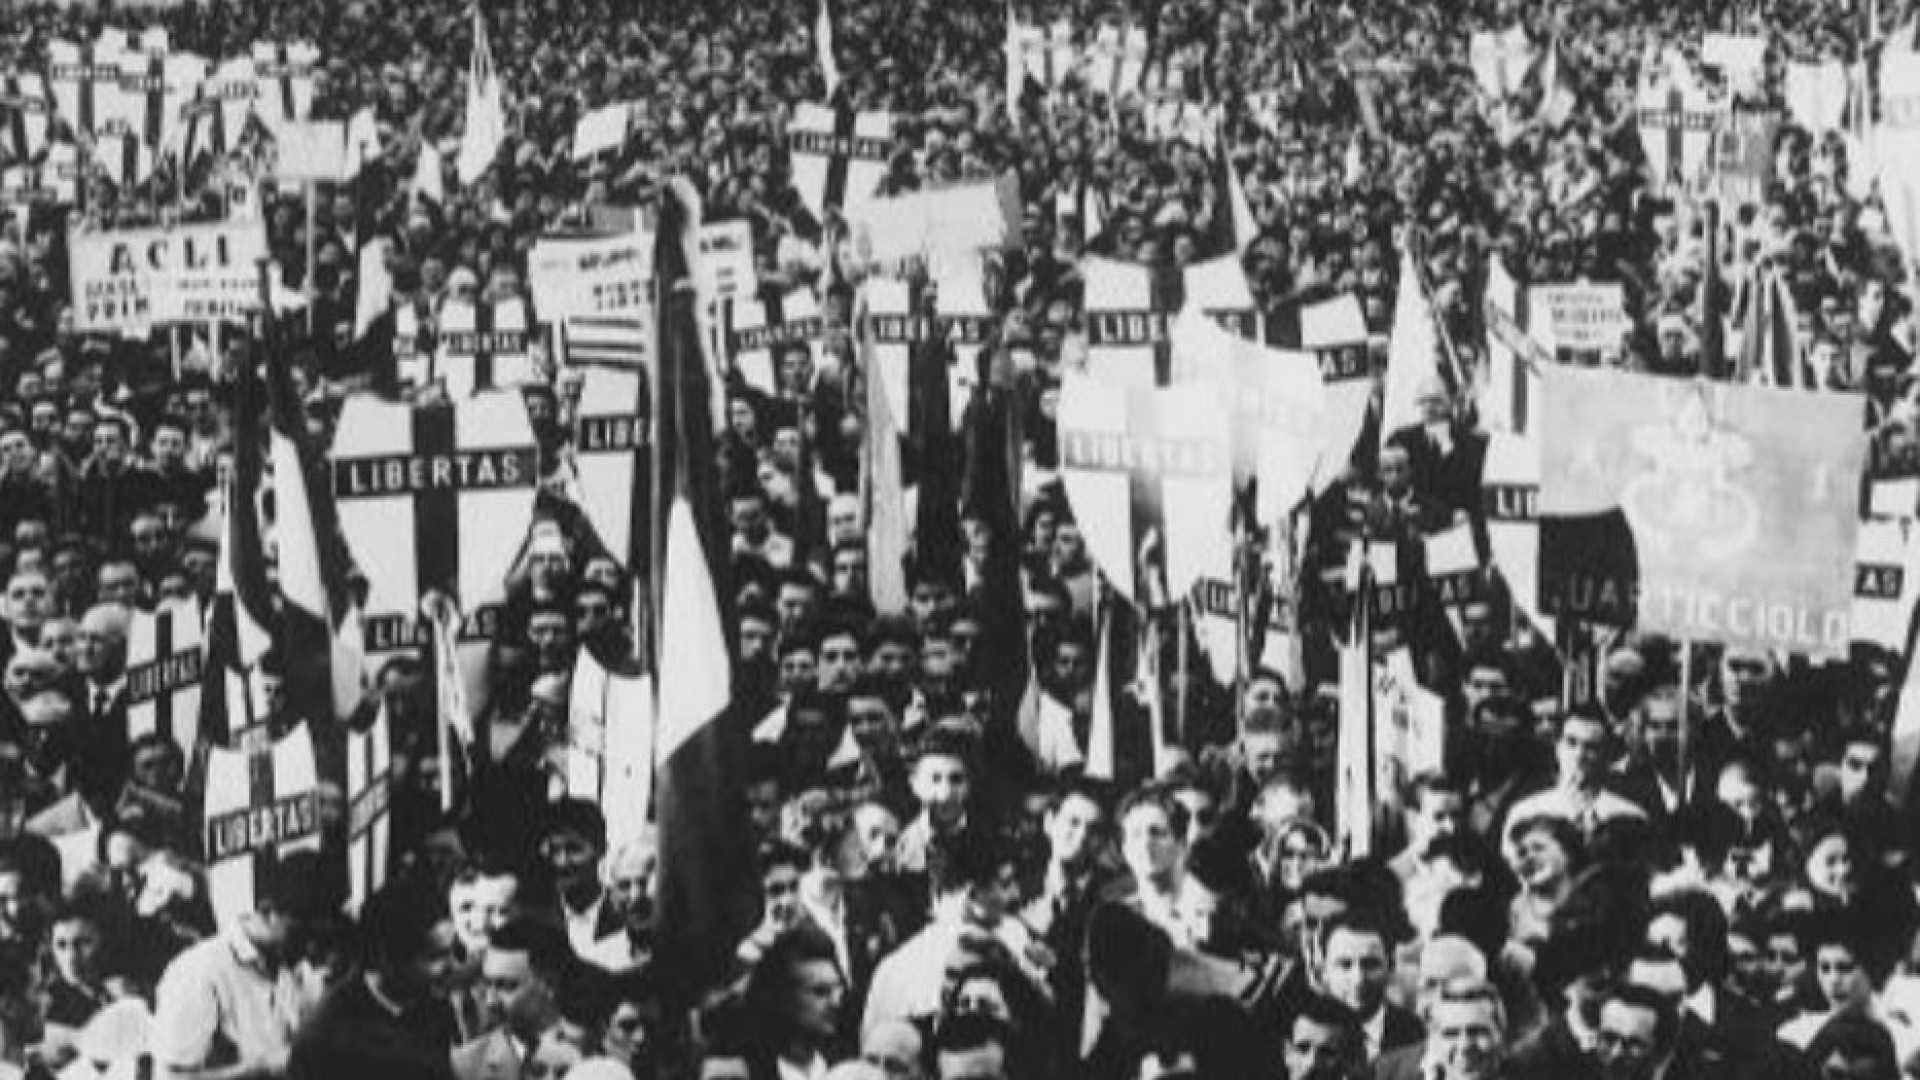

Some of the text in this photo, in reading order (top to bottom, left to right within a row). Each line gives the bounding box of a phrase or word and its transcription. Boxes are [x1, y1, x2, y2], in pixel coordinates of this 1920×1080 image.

[110, 234, 229, 275] ACLI
[351, 452, 521, 493] LIBERTAS
[216, 796, 314, 856] LIBERTAS
